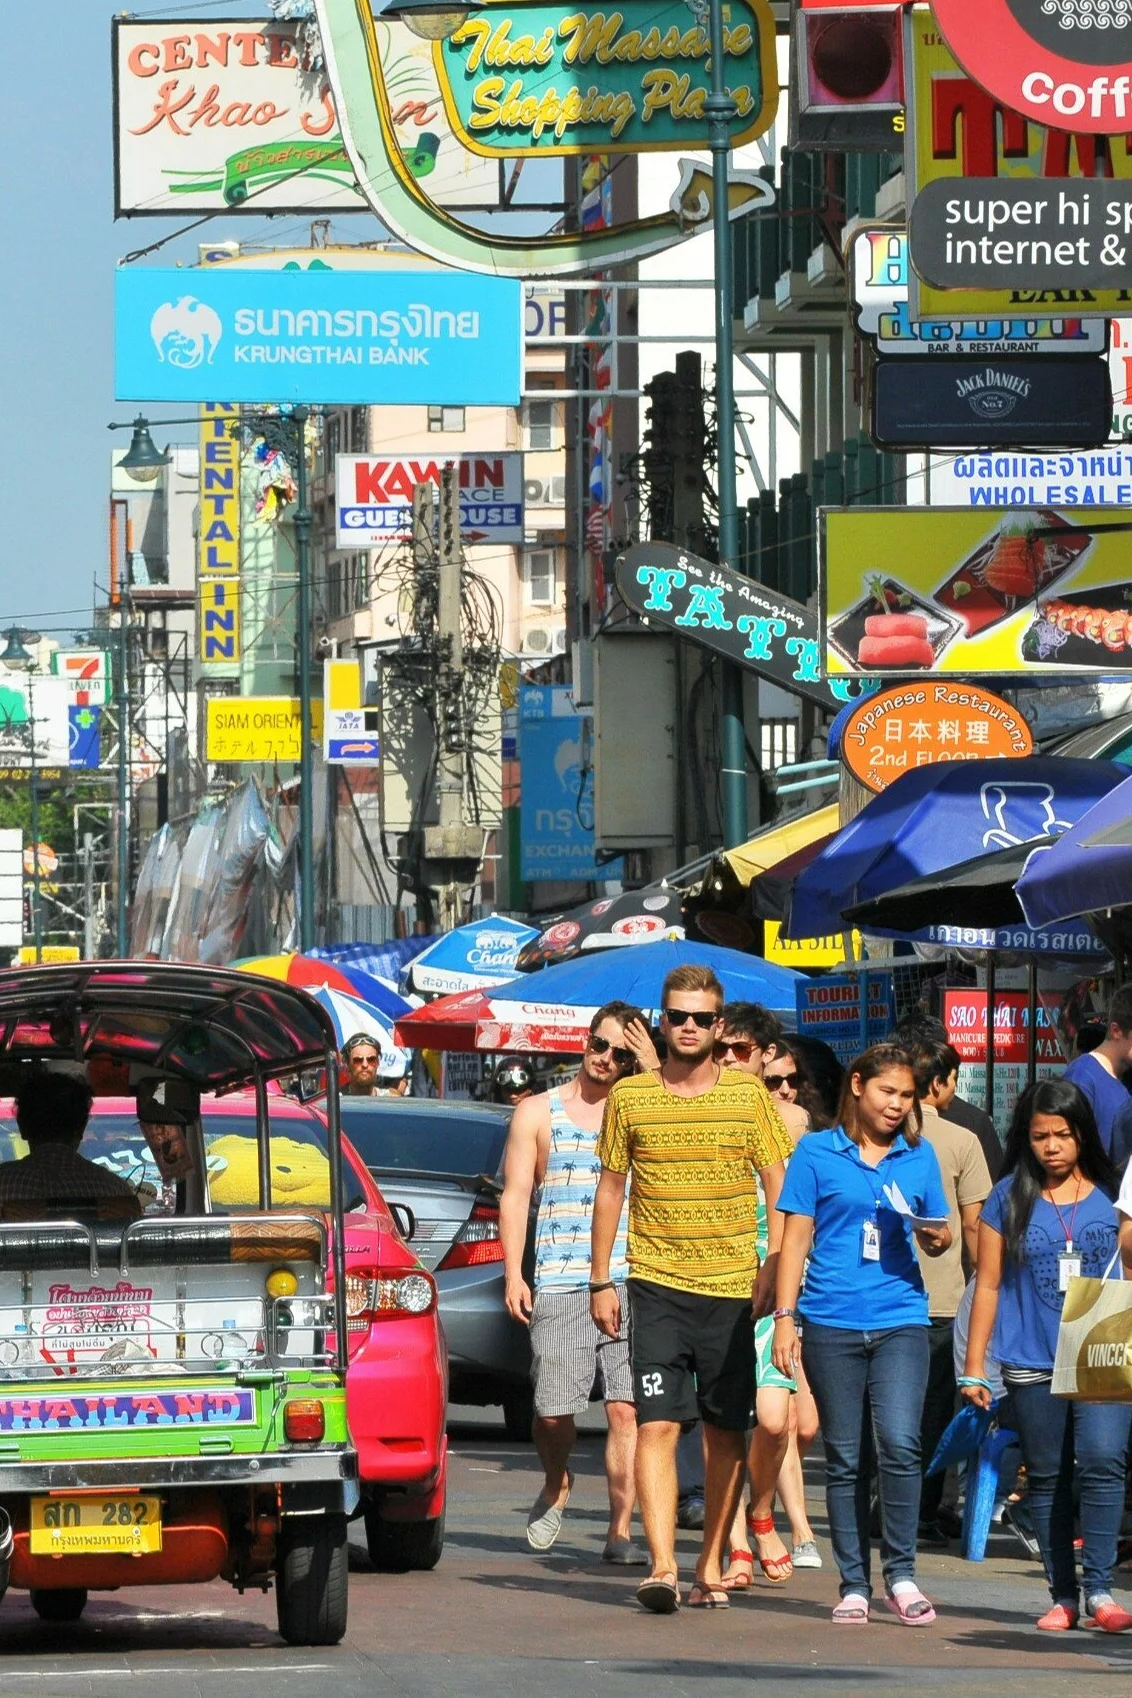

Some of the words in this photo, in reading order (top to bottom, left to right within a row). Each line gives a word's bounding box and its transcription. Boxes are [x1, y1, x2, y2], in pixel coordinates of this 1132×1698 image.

[127, 32, 299, 78] CENTE
[451, 19, 554, 73] Thai
[559, 12, 755, 72] Massae
[127, 79, 290, 136] Khao
[469, 76, 635, 138] Shopping
[642, 68, 755, 122] Plaa
[945, 198, 1048, 233] super
[1059, 192, 1090, 225] hi
[945, 233, 1091, 265] internet
[1099, 234, 1127, 266] &
[234, 303, 480, 347] ธนาคารกรุงไทย
[234, 345, 363, 365] KRUNGTHAI
[369, 346, 430, 366] BANK
[928, 342, 950, 352] BAR
[955, 342, 964, 352] &
[969, 342, 1040, 352] RESTAURANT
[956, 373, 985, 397] JACK
[953, 451, 1132, 478] ผลิตและจำหน่า
[204, 402, 235, 568] IENTAL
[459, 488, 505, 502] ACE
[344, 509, 414, 528] GUES
[676, 556, 704, 578] See
[709, 571, 734, 592] the
[204, 583, 235, 658] INN
[215, 713, 249, 730] SIAM
[848, 690, 927, 747] Japanese
[934, 686, 1027, 752] Restaurant
[884, 718, 990, 745] 日本料理
[869, 745, 907, 767] 2nd
[524, 845, 595, 857] EXCHAN
[805, 982, 882, 1006] TOURIT
[521, 1003, 576, 1018] Chang
[801, 1003, 889, 1025] INFORMAION
[949, 1005, 977, 1027] SAO
[949, 1032, 986, 1044] MANICURE
[641, 1372, 665, 1398] 52
[43, 1501, 81, 1527] สก
[102, 1501, 148, 1526] 282
[51, 1535, 141, 1550] กรุงเทพมหานคร
